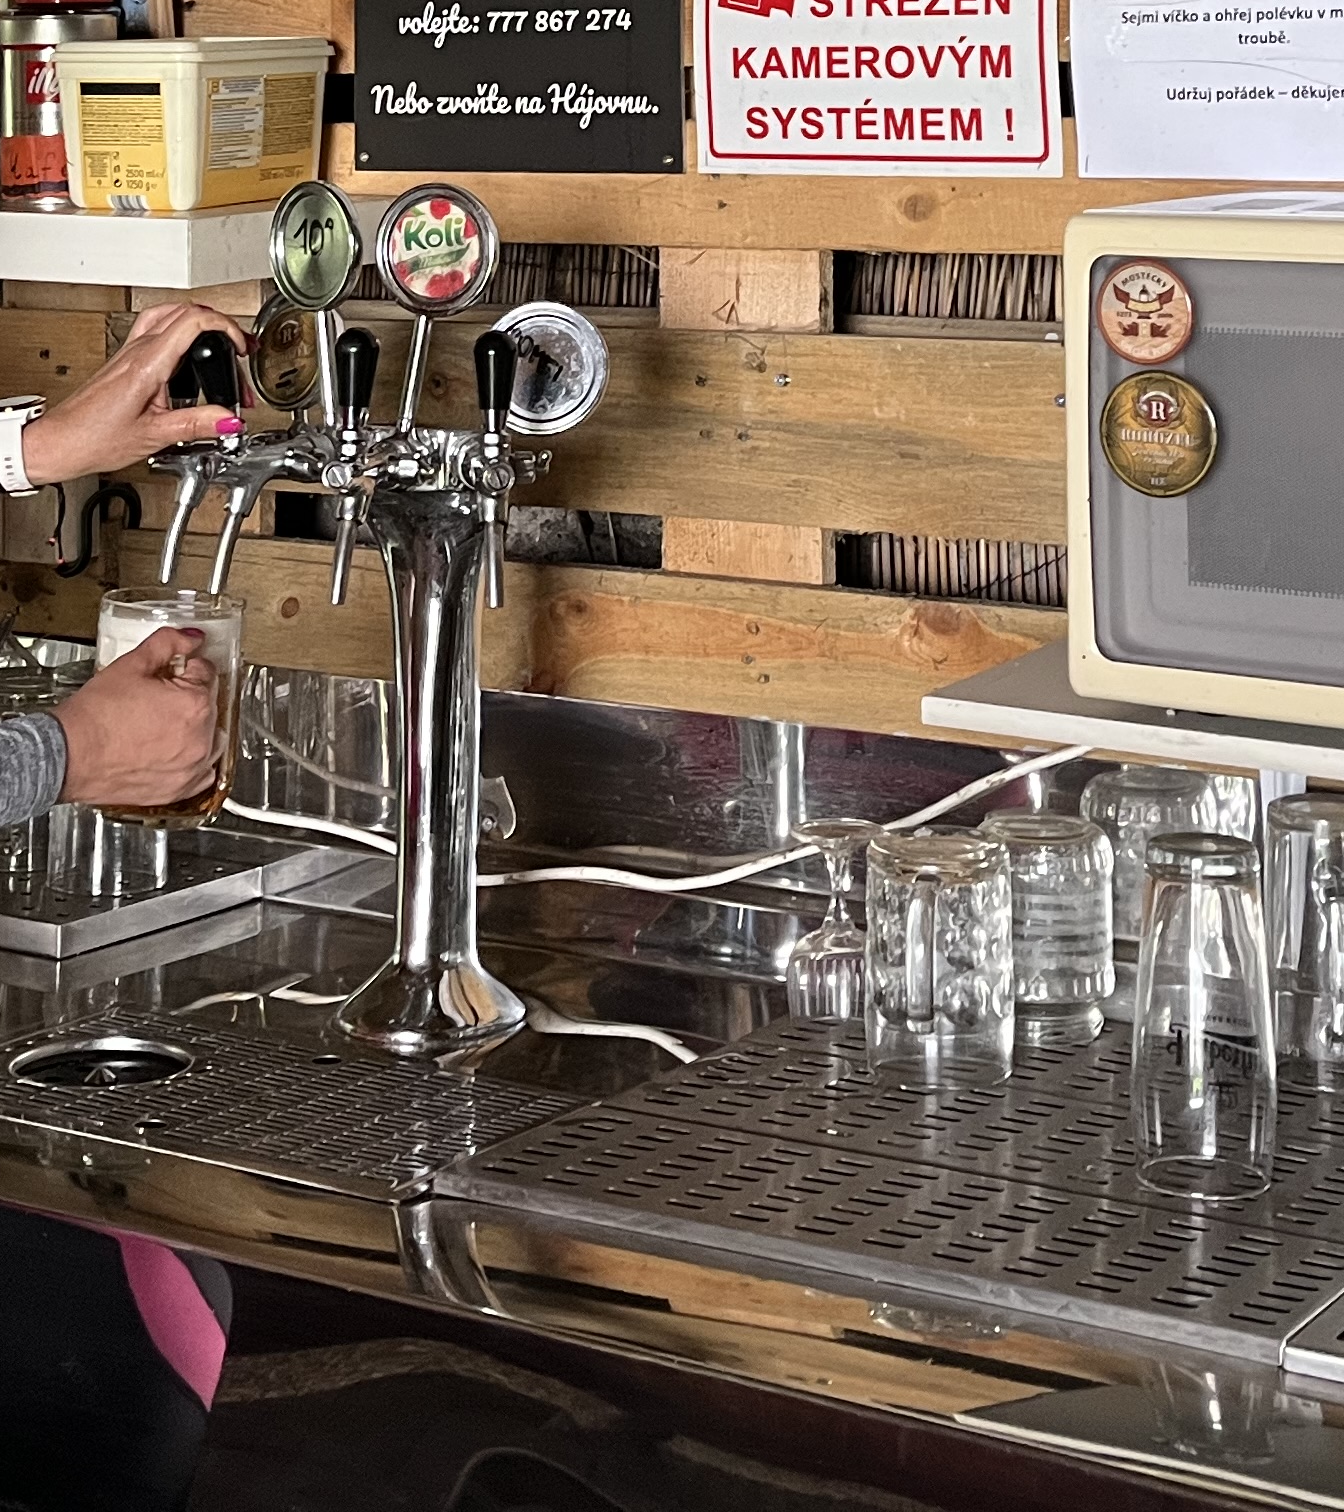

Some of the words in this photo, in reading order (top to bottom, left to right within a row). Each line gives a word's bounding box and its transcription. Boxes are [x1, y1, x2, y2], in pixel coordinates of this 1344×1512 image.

[398, 2, 479, 49] volejte:
[486, 11, 530, 35] 777
[534, 10, 574, 34] 867
[586, 9, 632, 33] 274
[1121, 10, 1159, 26] Sejmi
[1163, 8, 1198, 23] víčko
[1203, 12, 1210, 22] a
[1215, 6, 1252, 24] ohřej
[1256, 5, 1313, 24] polévku
[1317, 10, 1326, 18] v
[1238, 30, 1291, 45] troubě.
[732, 36, 1011, 80] KAMEROVÝM
[371, 83, 433, 117] Nebo
[436, 83, 511, 116] zvoňte
[513, 92, 545, 115] na
[546, 83, 660, 129] Hájovnu.
[1167, 86, 1212, 103] Udržuj
[1216, 86, 1275, 103] pořádek
[745, 99, 983, 142] SYSTÉMEM
[403, 217, 464, 251] Koli
[1150, 400, 1166, 421] R
